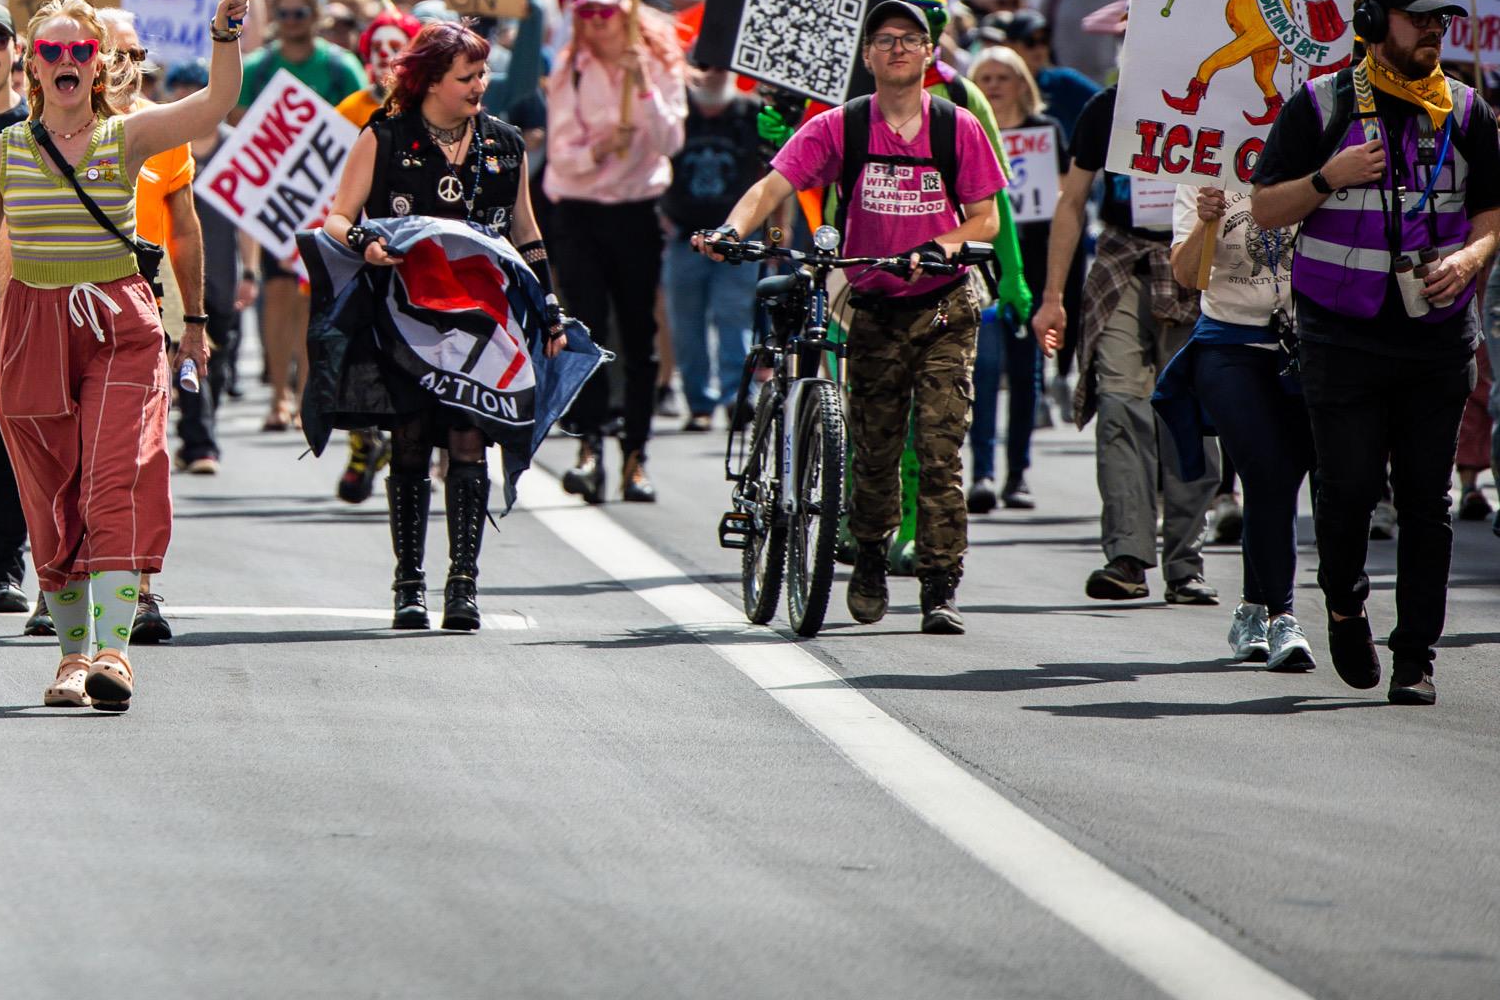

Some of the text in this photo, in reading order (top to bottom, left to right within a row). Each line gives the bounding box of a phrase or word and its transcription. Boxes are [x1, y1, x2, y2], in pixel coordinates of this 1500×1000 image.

[1294, 38, 1329, 63] BFF
[209, 85, 317, 217] PUNKS
[1129, 119, 1224, 177] ICE
[256, 121, 346, 244] HATE
[864, 189, 918, 201] PLANNED
[923, 180, 940, 190] ICE
[863, 201, 942, 213] PARENTHOOD
[419, 371, 519, 418] ACTION
